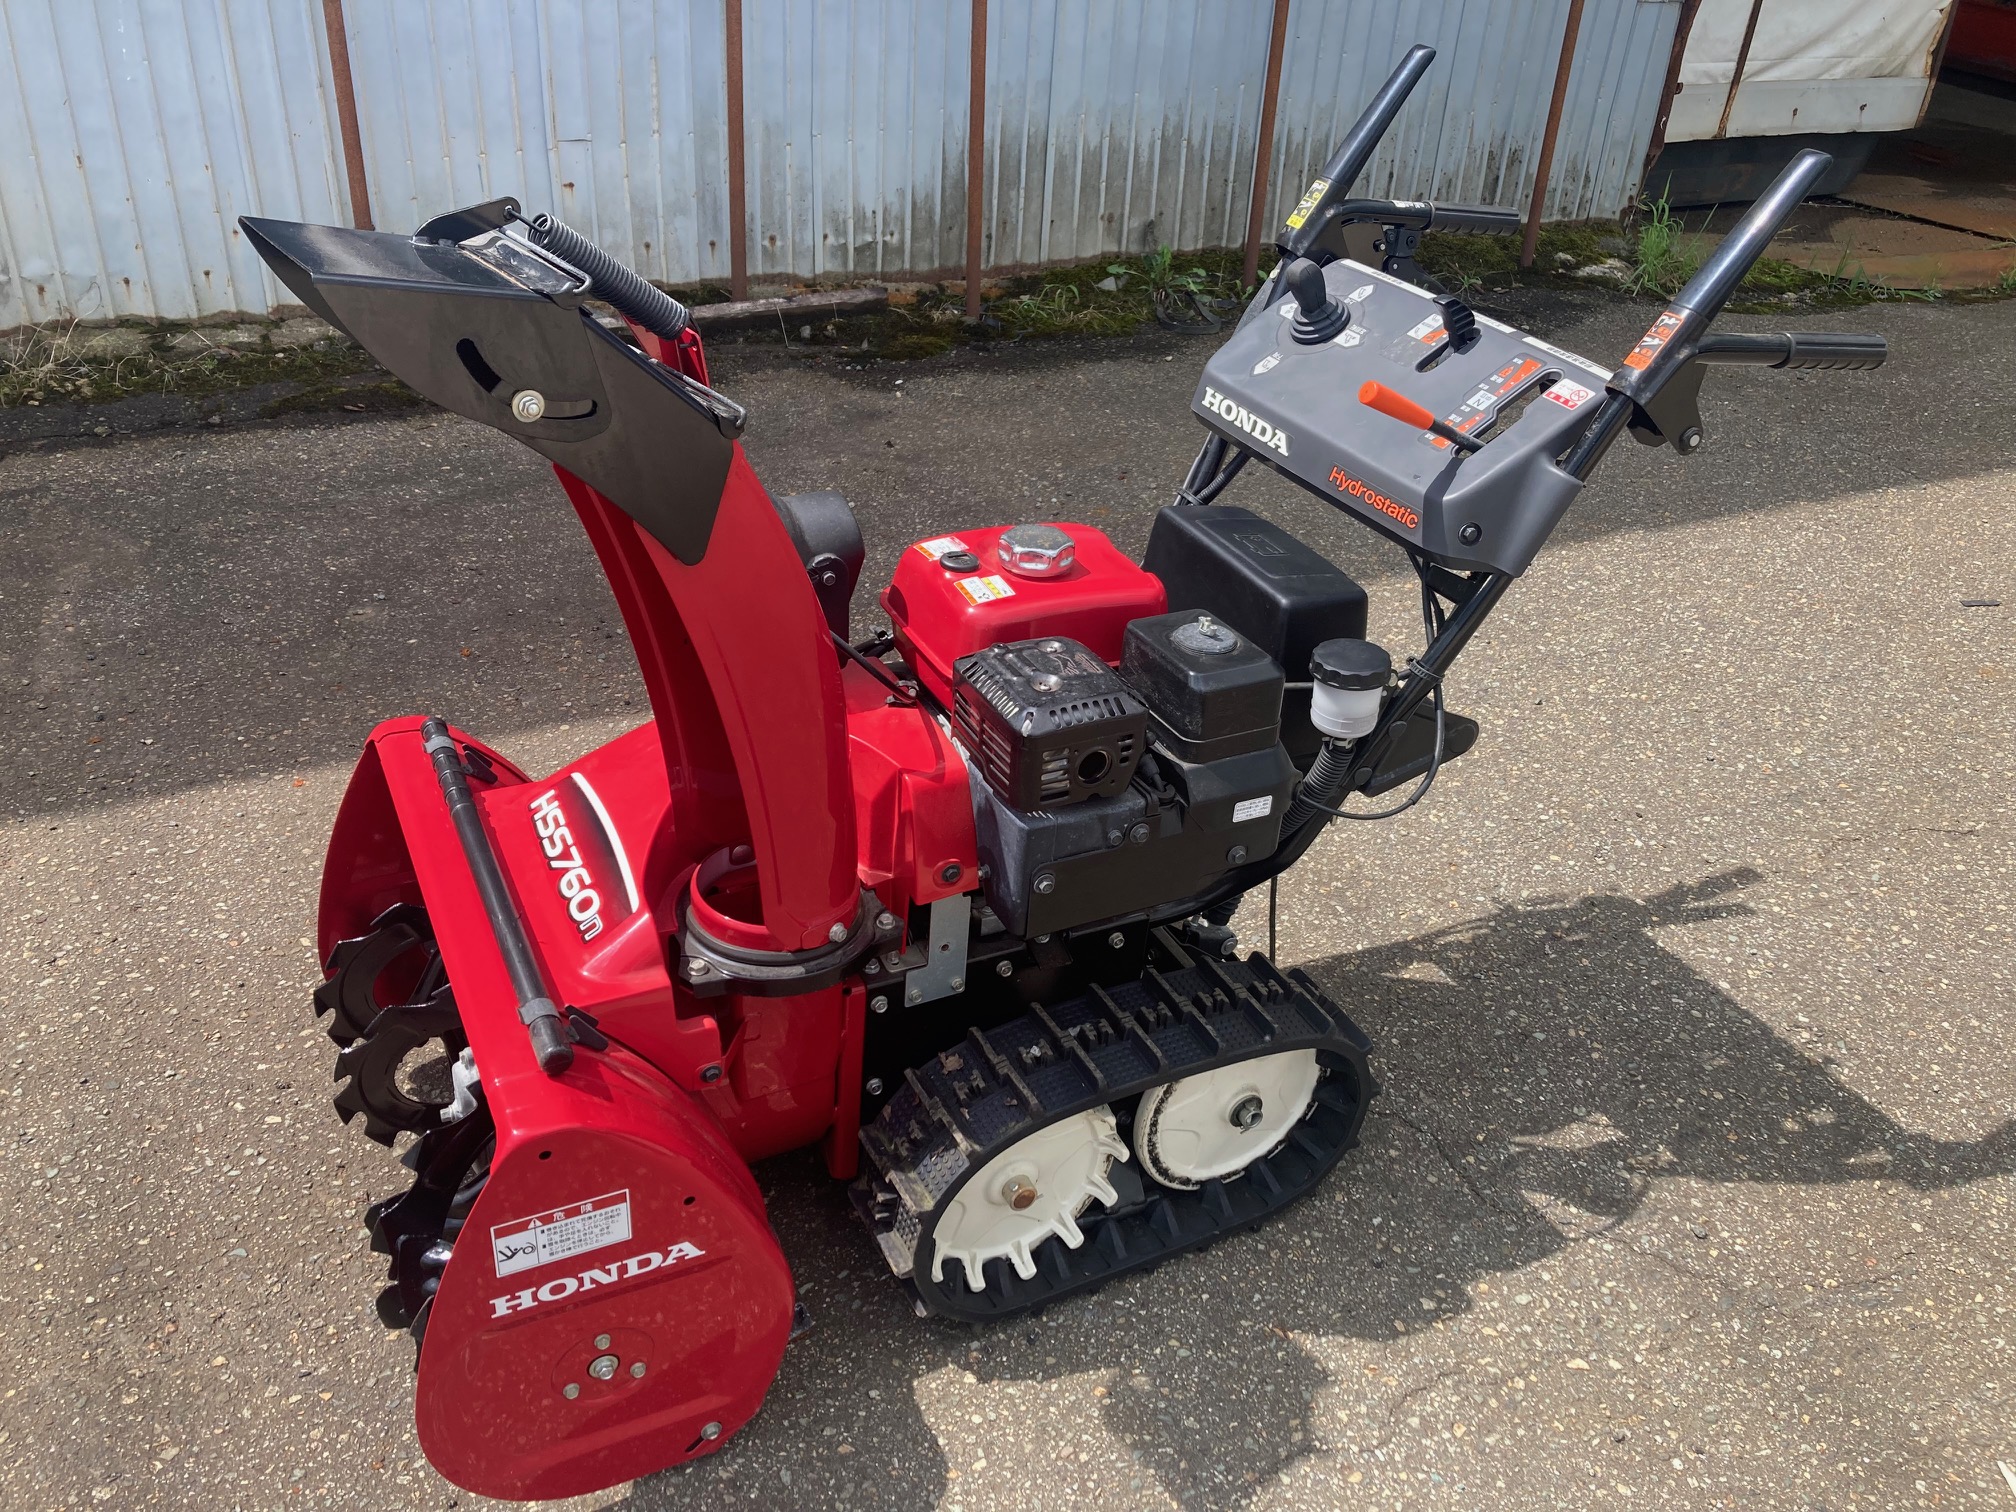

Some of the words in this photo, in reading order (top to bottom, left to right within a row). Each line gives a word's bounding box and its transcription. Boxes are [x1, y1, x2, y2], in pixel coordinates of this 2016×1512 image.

[1201, 386, 1290, 456] HONDA
[1329, 466, 1418, 529] Hydrostatic
[529, 789, 603, 942] HSS760n
[490, 1242, 705, 1319] HONDA
